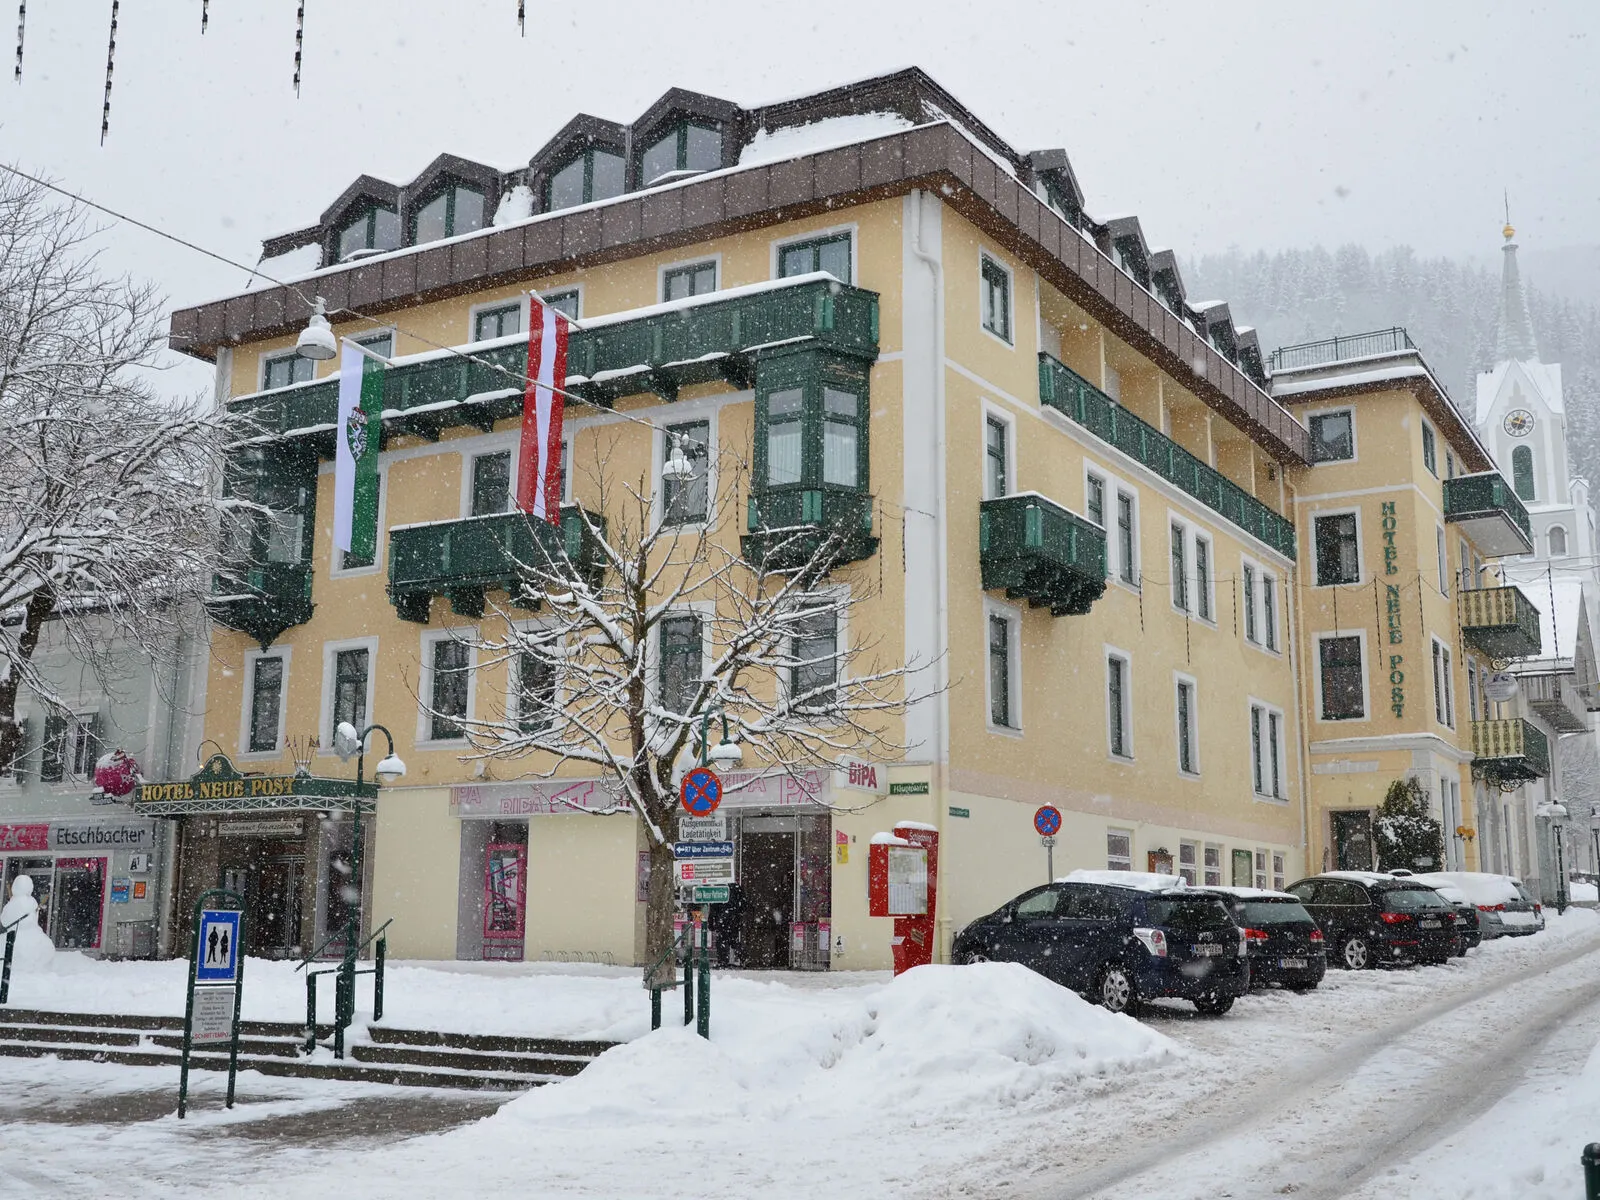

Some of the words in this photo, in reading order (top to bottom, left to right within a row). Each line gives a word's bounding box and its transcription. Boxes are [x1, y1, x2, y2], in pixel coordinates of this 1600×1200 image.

[1382, 501, 1398, 575] HOTEL
[1386, 584, 1402, 645] NEUE
[1390, 655, 1405, 718] POST
[141, 783, 194, 801] HOTEL
[200, 780, 245, 798] NEUE
[251, 777, 296, 797] POST
[848, 760, 878, 789] BIPA
[57, 825, 146, 845] Etschbacher
